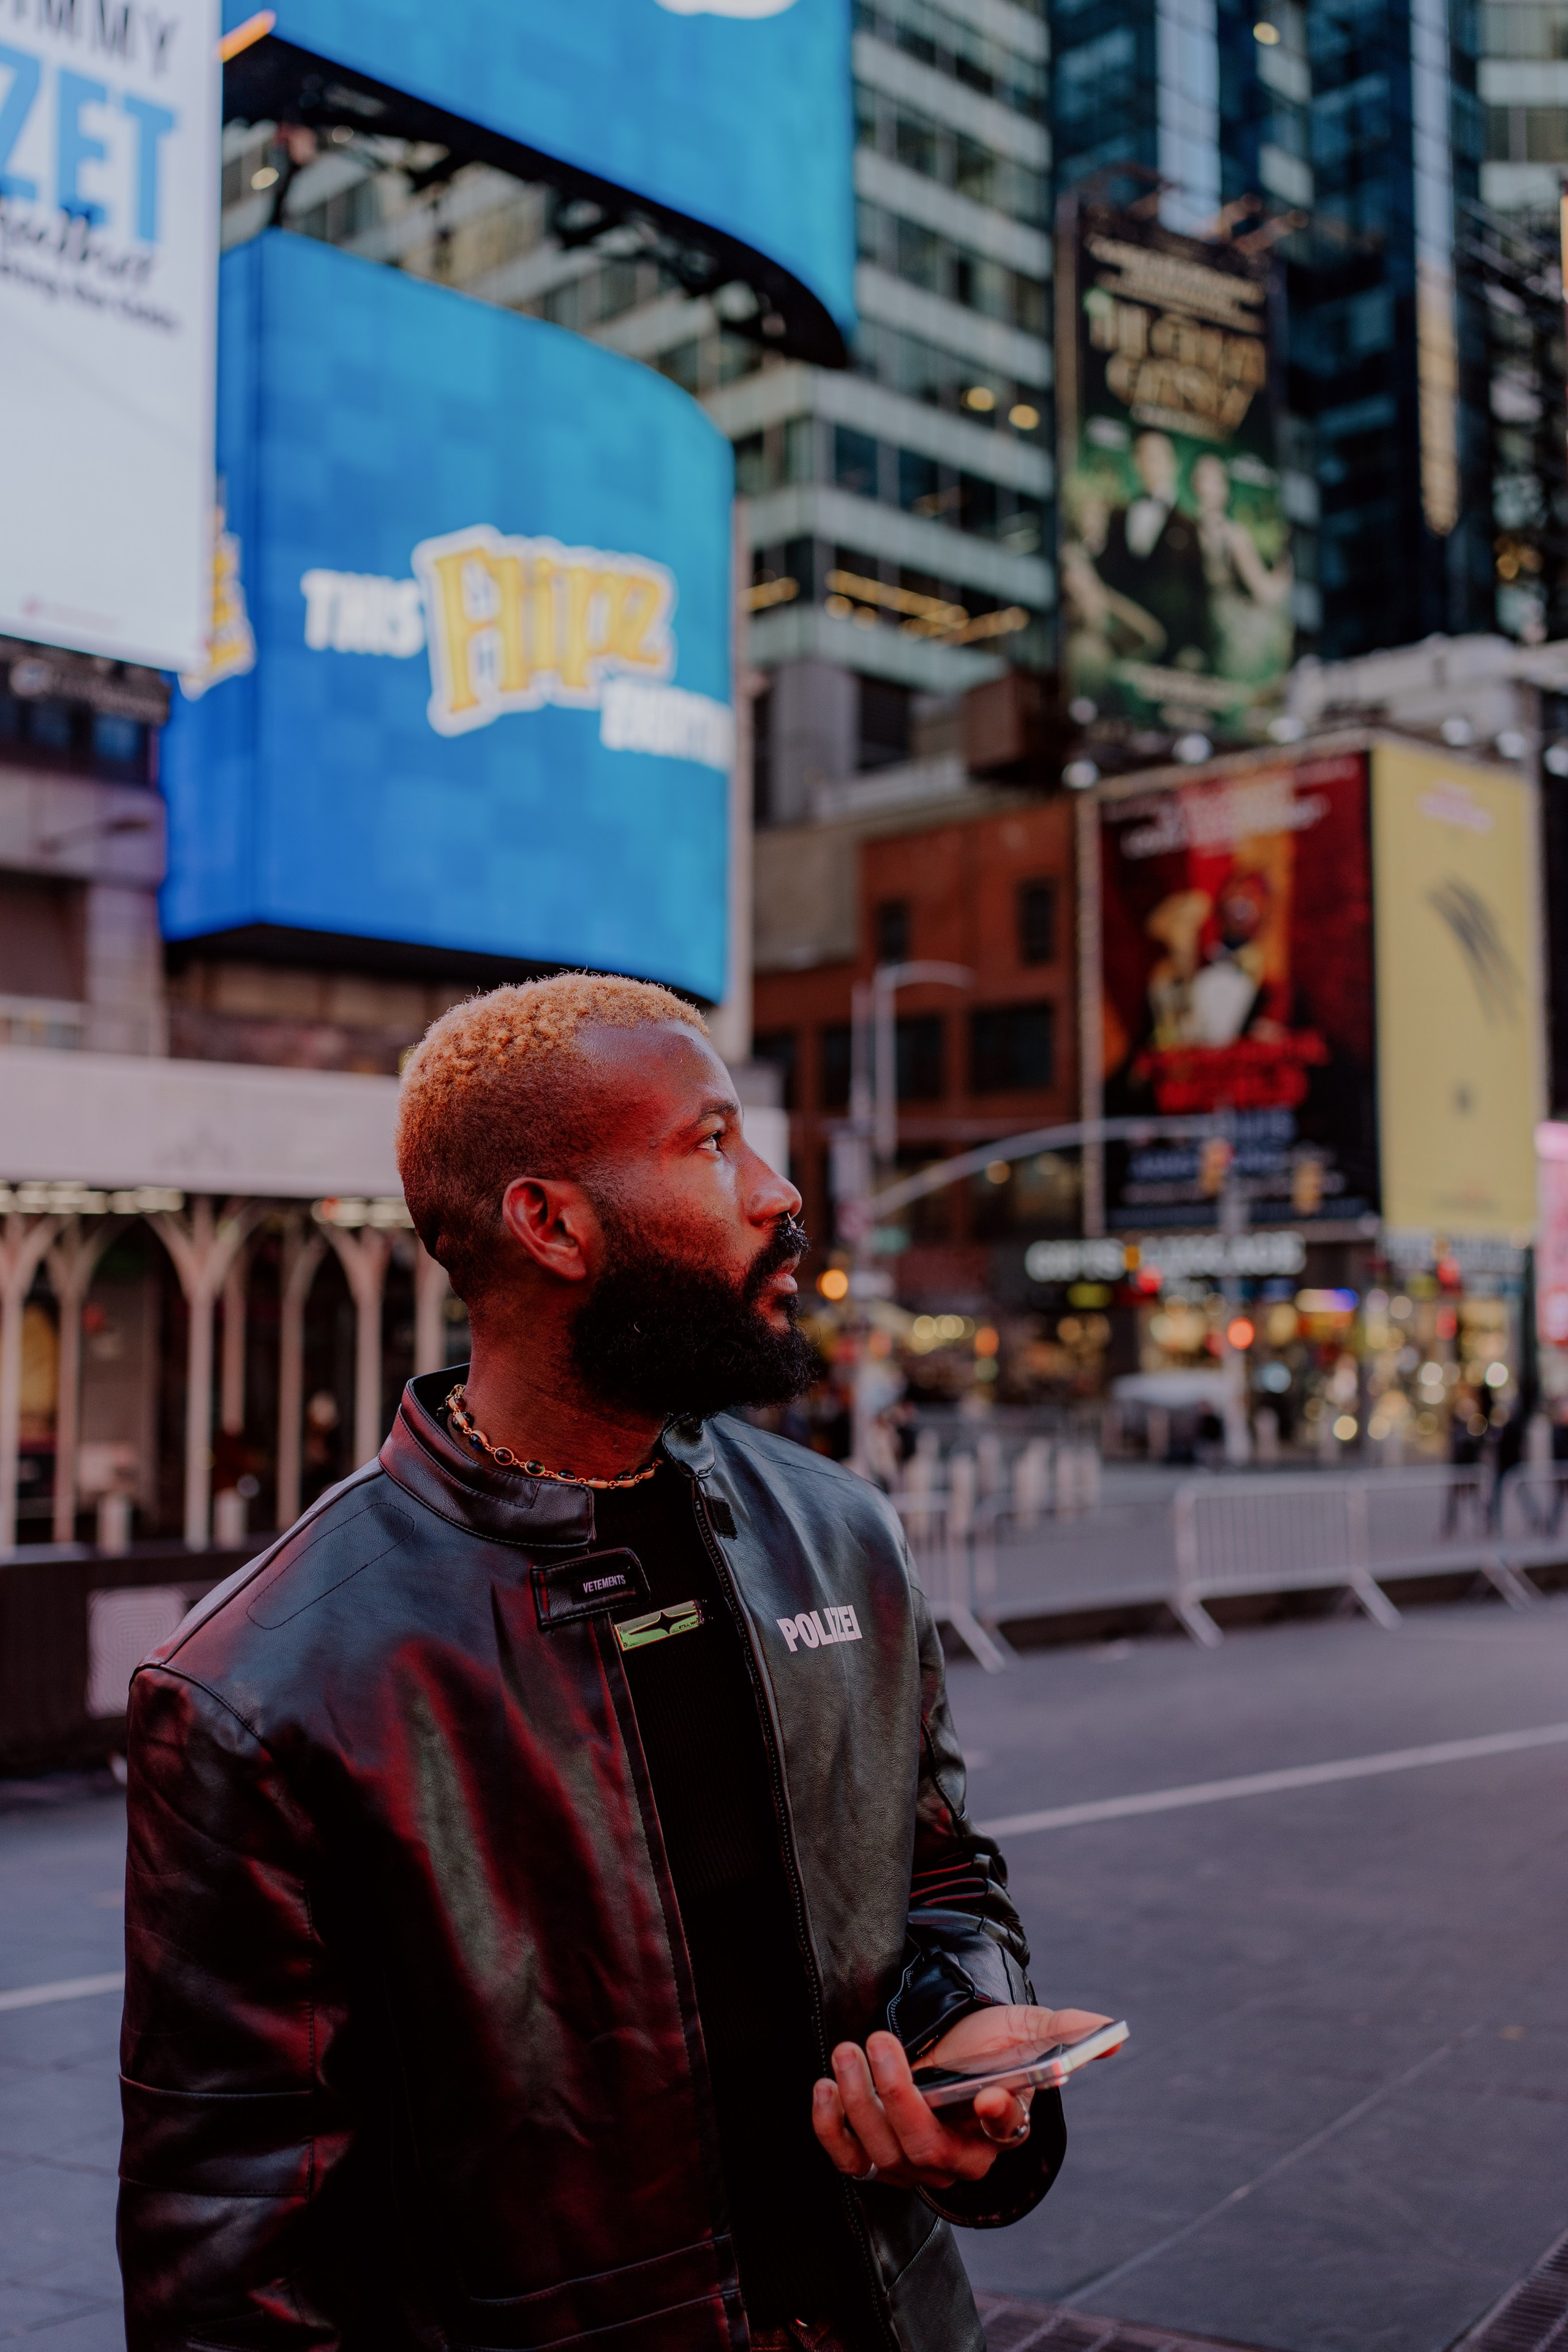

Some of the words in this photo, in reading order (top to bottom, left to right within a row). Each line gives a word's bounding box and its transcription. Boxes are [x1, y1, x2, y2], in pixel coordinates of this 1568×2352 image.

[300, 568, 425, 658] THIS
[583, 1575, 626, 1593] VETEMENTS
[776, 1605, 863, 1653] POLIZEI
